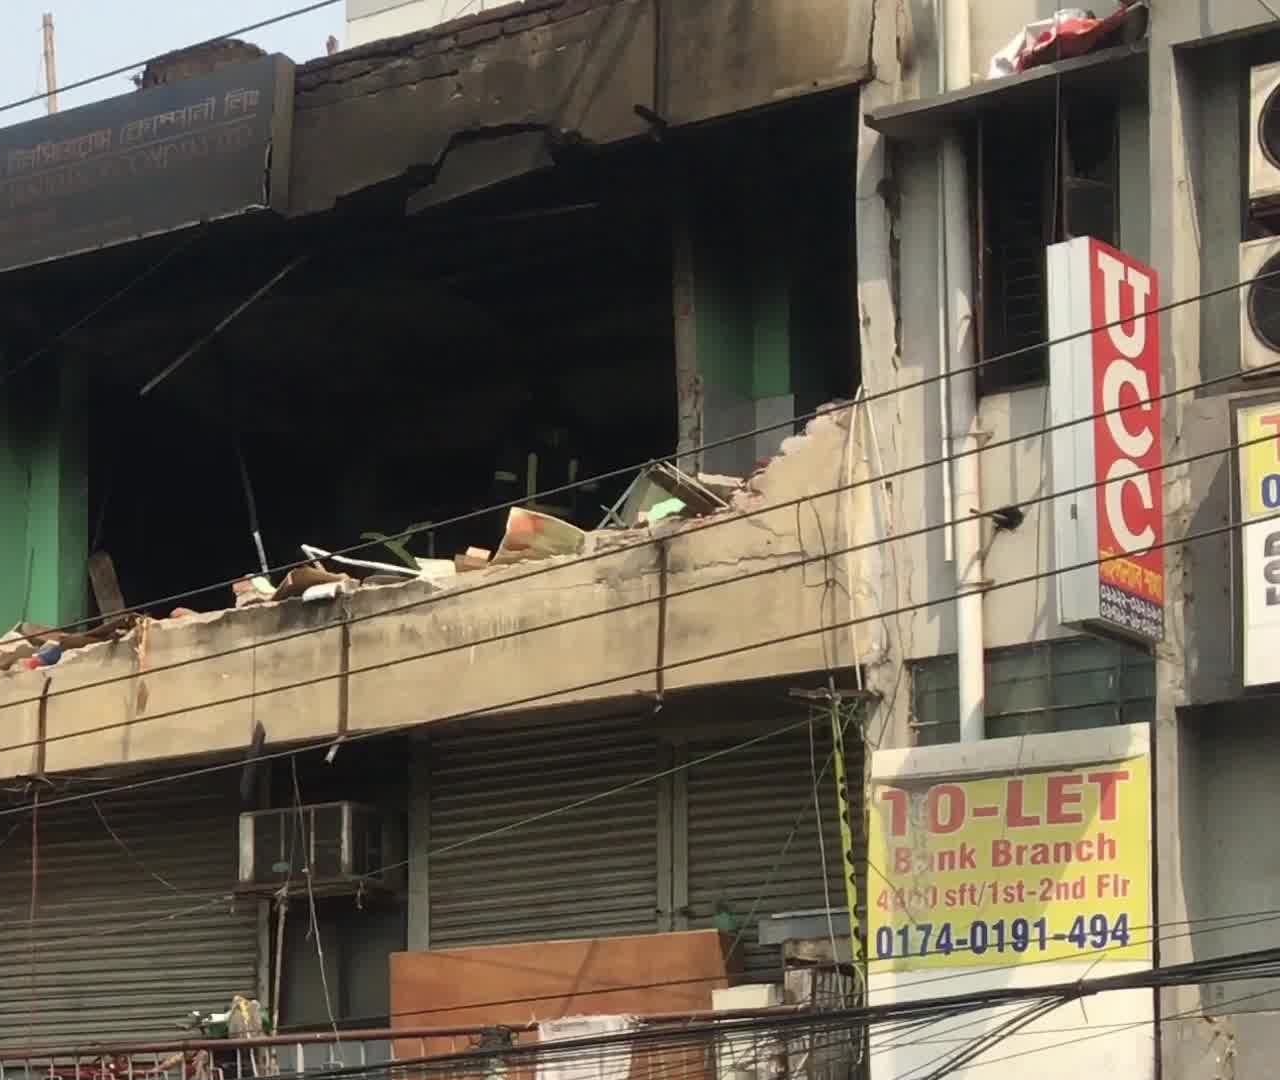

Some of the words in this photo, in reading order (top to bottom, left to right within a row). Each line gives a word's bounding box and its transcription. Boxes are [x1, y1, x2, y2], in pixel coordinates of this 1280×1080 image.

[1097, 249, 1157, 558] UCC
[881, 770, 1129, 838] TO-LET
[991, 832, 1116, 868] Branch
[944, 875, 1086, 910] sft/1st-2nd
[1097, 873, 1131, 898] Flr
[876, 912, 1130, 961] 0174-0191-494
